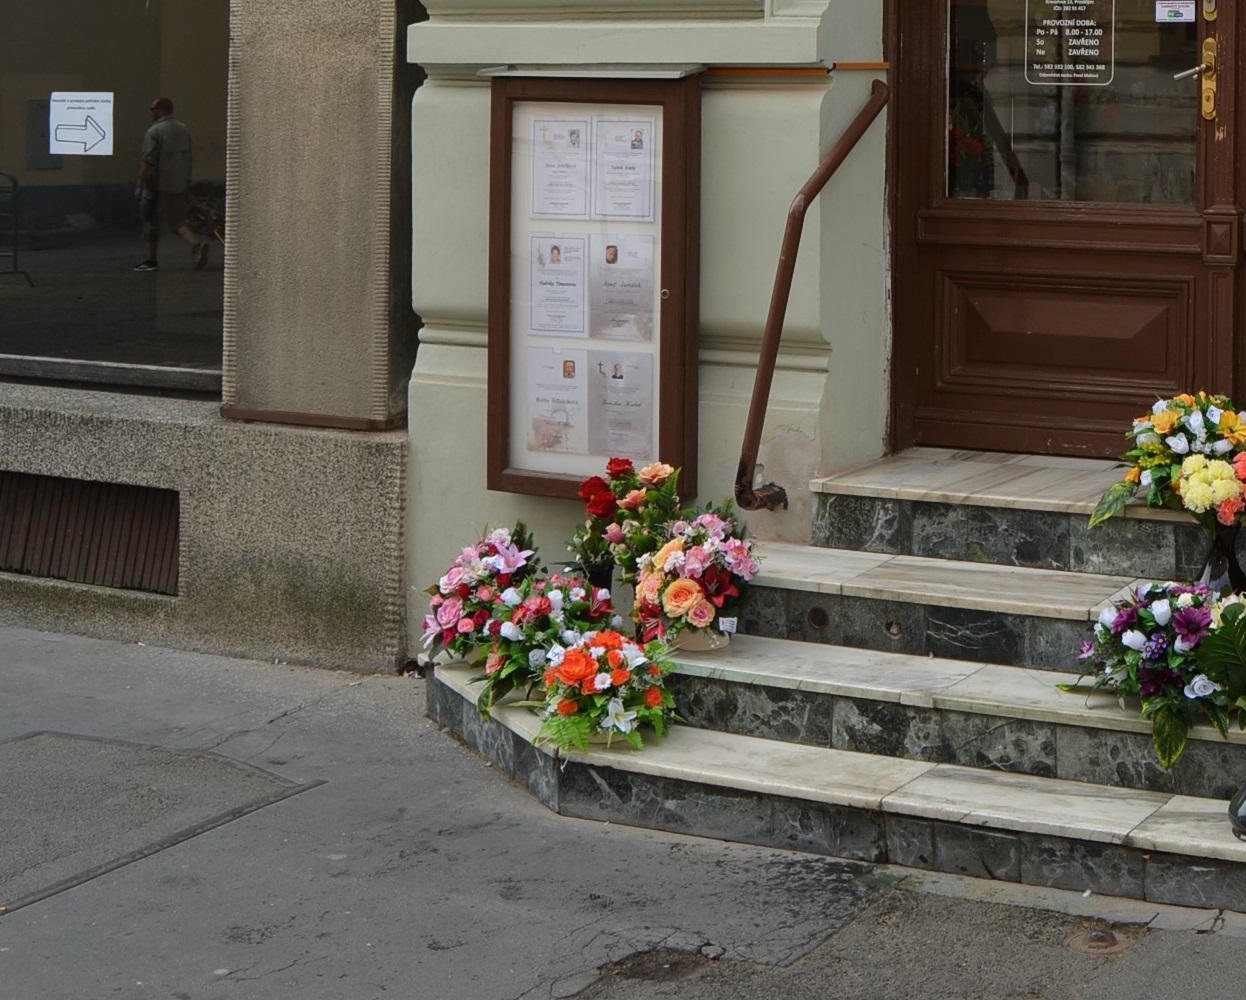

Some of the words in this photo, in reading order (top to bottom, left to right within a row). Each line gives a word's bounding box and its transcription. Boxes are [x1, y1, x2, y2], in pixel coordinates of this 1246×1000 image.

[1042, 18, 1075, 26] PROVOZNÍ
[1036, 38, 1045, 46] So
[1068, 37, 1100, 46] ZAVŘENO
[1036, 48, 1046, 56] Ne
[1068, 47, 1100, 56] ZAVŘENO
